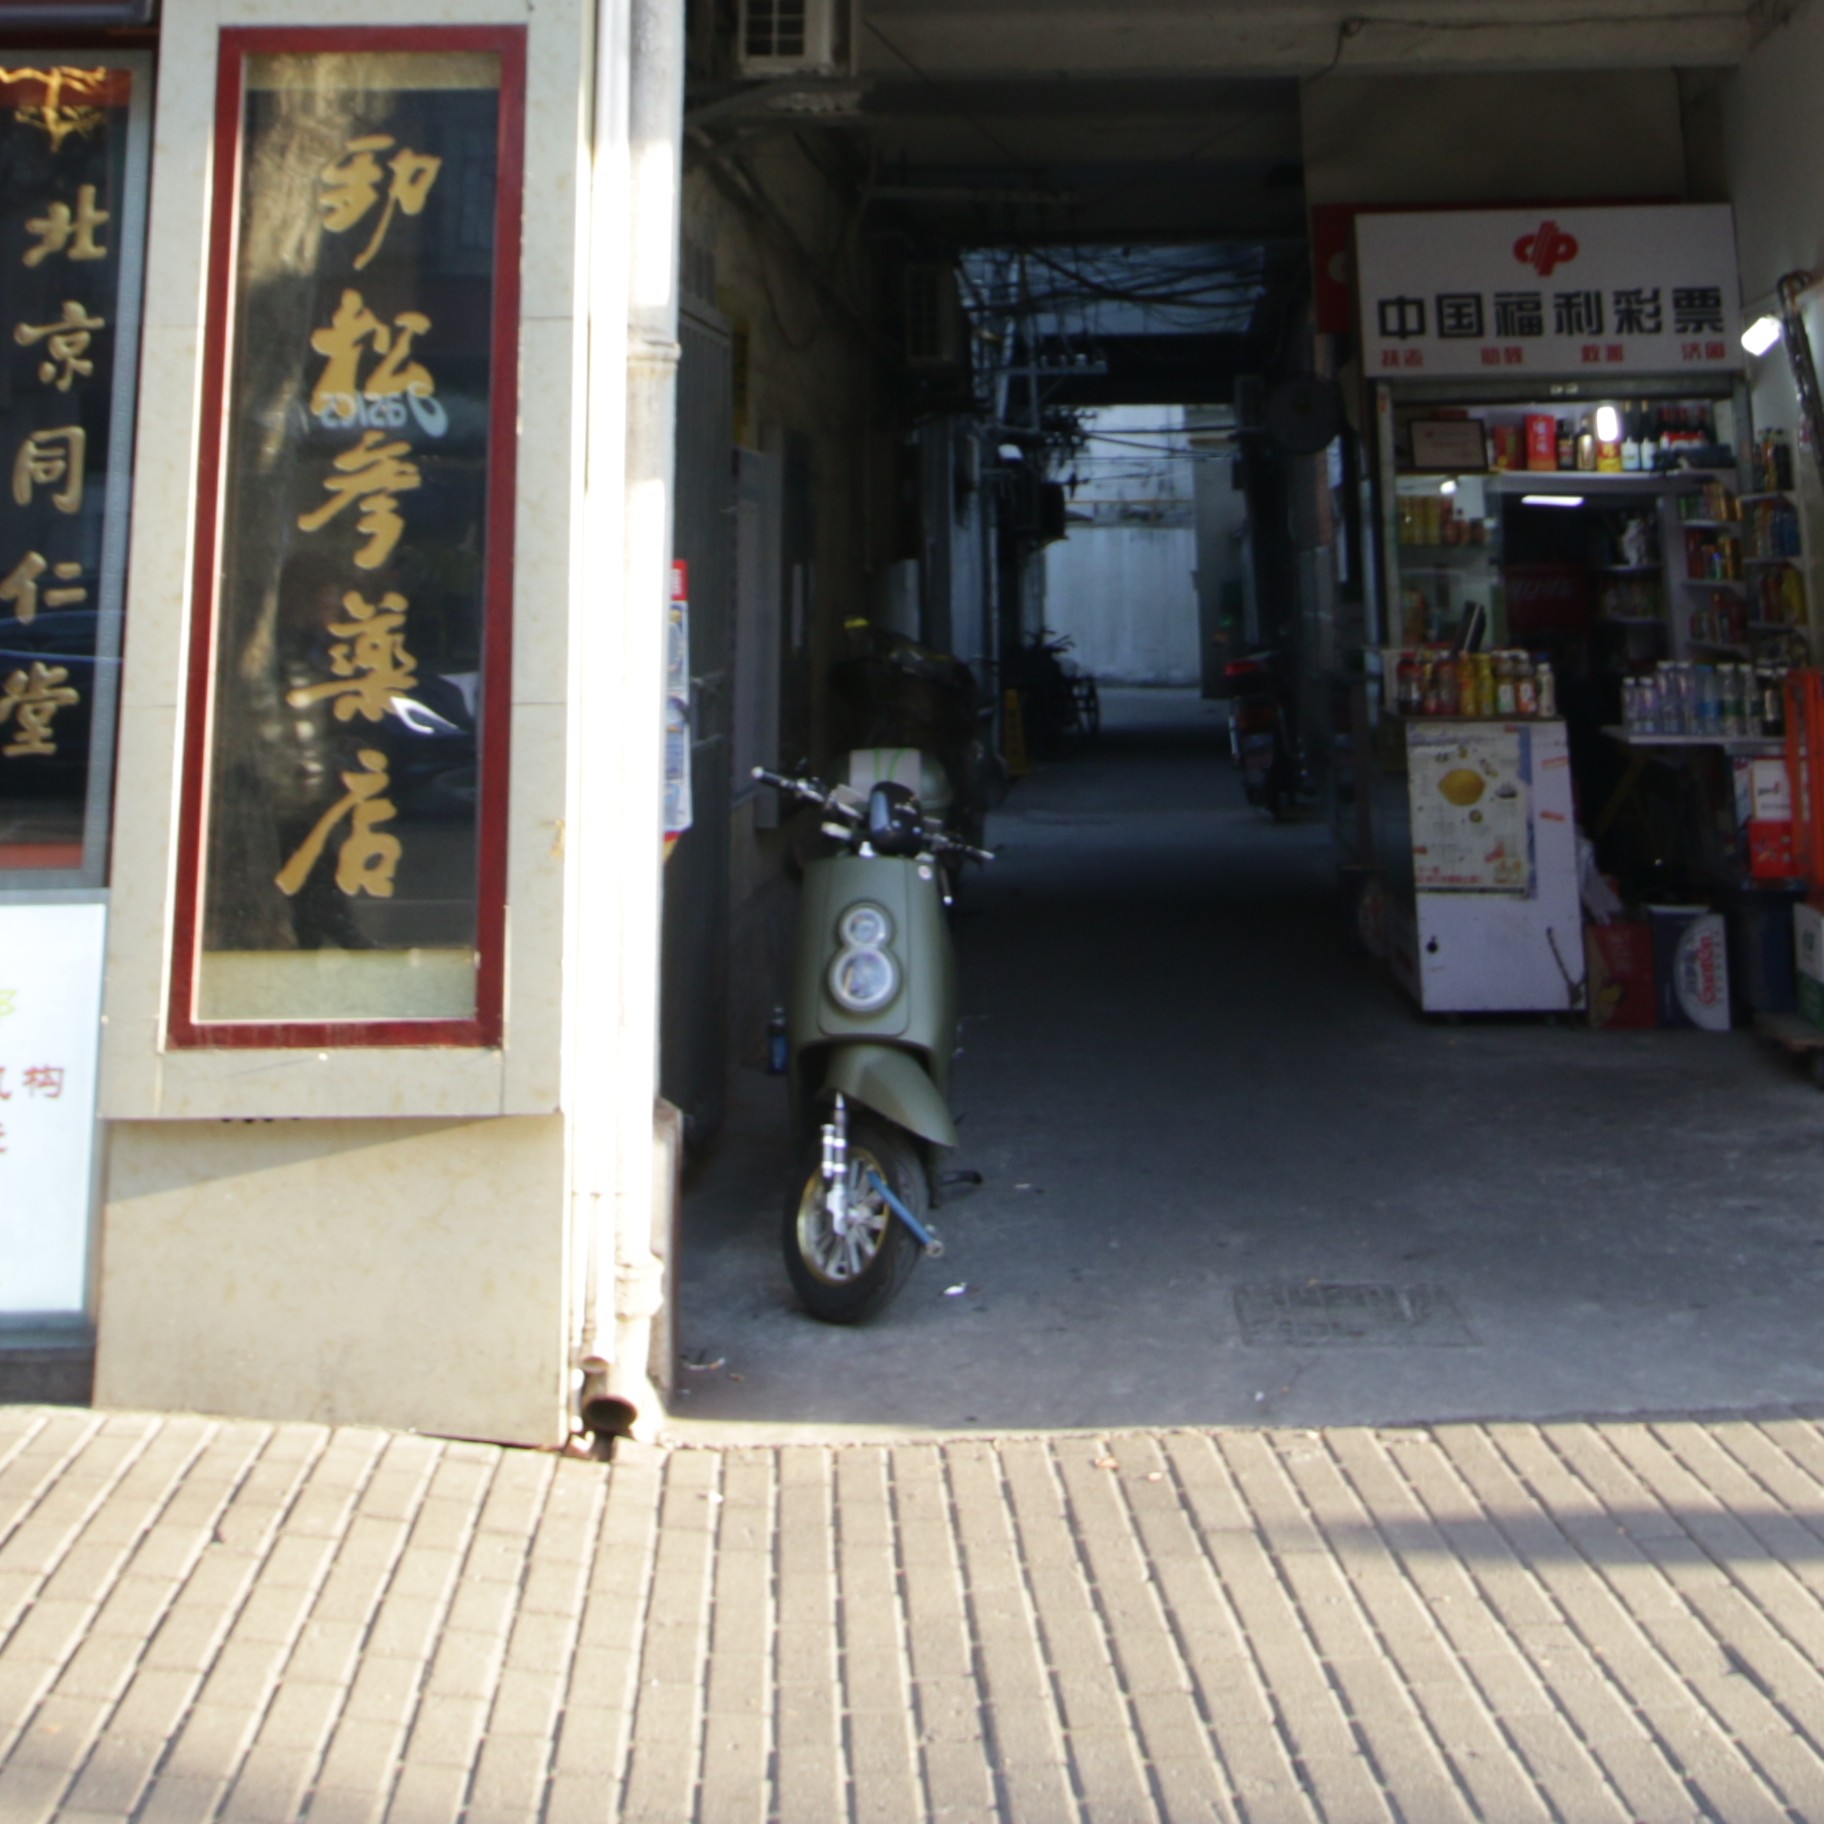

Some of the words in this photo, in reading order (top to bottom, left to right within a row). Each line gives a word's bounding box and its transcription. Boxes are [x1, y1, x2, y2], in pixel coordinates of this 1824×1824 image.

[1378, 288, 1725, 342] 中国福利彩票
